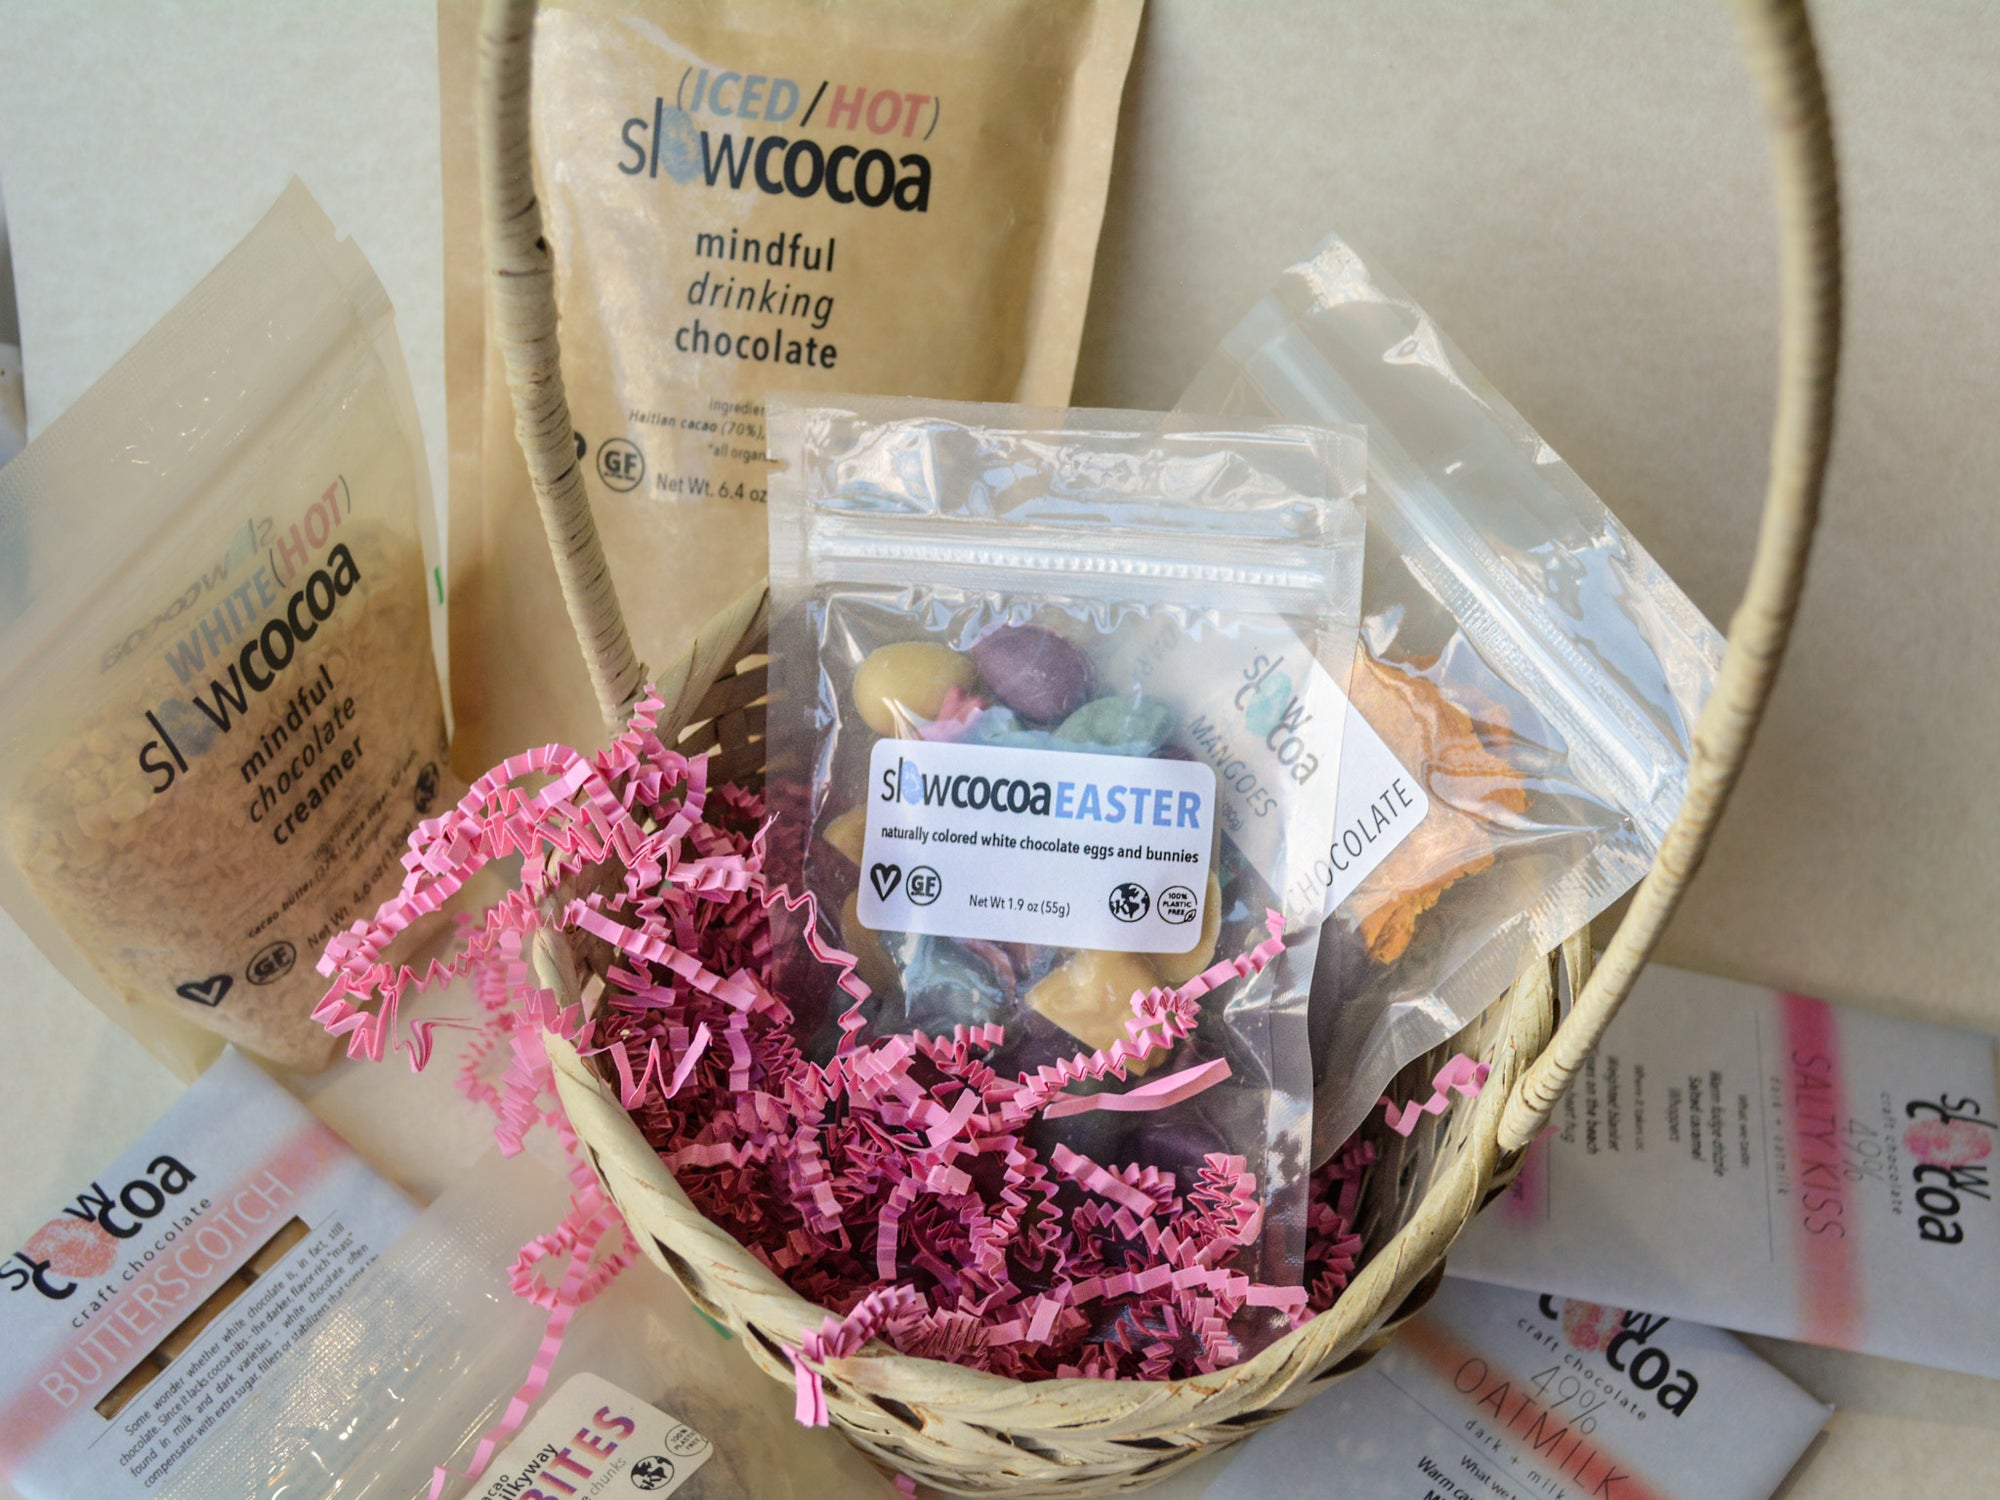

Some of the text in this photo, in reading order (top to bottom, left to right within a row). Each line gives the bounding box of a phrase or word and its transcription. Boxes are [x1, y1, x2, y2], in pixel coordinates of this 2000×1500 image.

[695, 228, 835, 271] mindful
[675, 319, 838, 369] chocolate
[688, 272, 834, 330] drinking
[629, 409, 675, 427] Haitian
[680, 418, 717, 433] cacao
[656, 474, 684, 491] Net
[688, 480, 714, 496] Wt.
[719, 482, 744, 499] 6.4
[750, 489, 767, 503] oz
[240, 664, 336, 785] mindful
[249, 695, 357, 825] chocolate
[1189, 715, 1277, 818] MANGOES
[274, 736, 363, 845] creamer
[881, 826, 1199, 863] naturally colored white chocolate eggs and bunnies
[969, 894, 1071, 918] Net Wt 1.9 oz (55g)
[1793, 1050, 1846, 1239] SALTY KISS
[39, 1170, 294, 1409] BUTTERSCOTCH
[72, 1198, 212, 1328] craft chocolate
[119, 1425, 161, 1466] chocolate.
[158, 1405, 182, 1427] Since
[181, 1395, 190, 1406] it
[186, 1377, 209, 1400] lacks
[207, 1355, 232, 1380] cocoa
[229, 1339, 249, 1357] nibs
[251, 1321, 268, 1335] the
[266, 1296, 294, 1322] darker,
[125, 1410, 151, 1436] Some
[153, 1378, 185, 1410] wonder
[187, 1343, 220, 1377] whether
[222, 1319, 246, 1342] white
[247, 1281, 285, 1318] chocolate
[298, 1258, 308, 1269] in
[130, 1448, 158, 1477] found
[159, 1437, 171, 1449] in
[172, 1414, 193, 1436] milk
[196, 1393, 213, 1414] and
[216, 1373, 236, 1394] dark
[237, 1338, 272, 1373] varieties
[283, 1304, 306, 1328] white
[308, 1266, 345, 1304] chocolate
[347, 1243, 369, 1265] often
[144, 1434, 198, 1488] compensates
[196, 1415, 216, 1436] with
[215, 1396, 236, 1418] extra
[235, 1373, 261, 1398] sugar,
[257, 1349, 283, 1374] fillers
[281, 1340, 292, 1352] or
[291, 1303, 330, 1341] stabilizers
[328, 1286, 345, 1304] that
[1517, 1316, 1559, 1354] craft
[1564, 1353, 1647, 1421] chocolate
[1454, 1357, 1629, 1500] OATMILK
[1531, 1365, 1605, 1435] 49%
[499, 1443, 558, 1500] ilkyway
[590, 1457, 626, 1495] chunks
[1417, 1456, 1455, 1491] Warm
[1461, 1454, 1491, 1485] What
[1491, 1479, 1509, 1497] we
[1465, 1419, 1502, 1452] dark
[1527, 1469, 1566, 1500] milk
